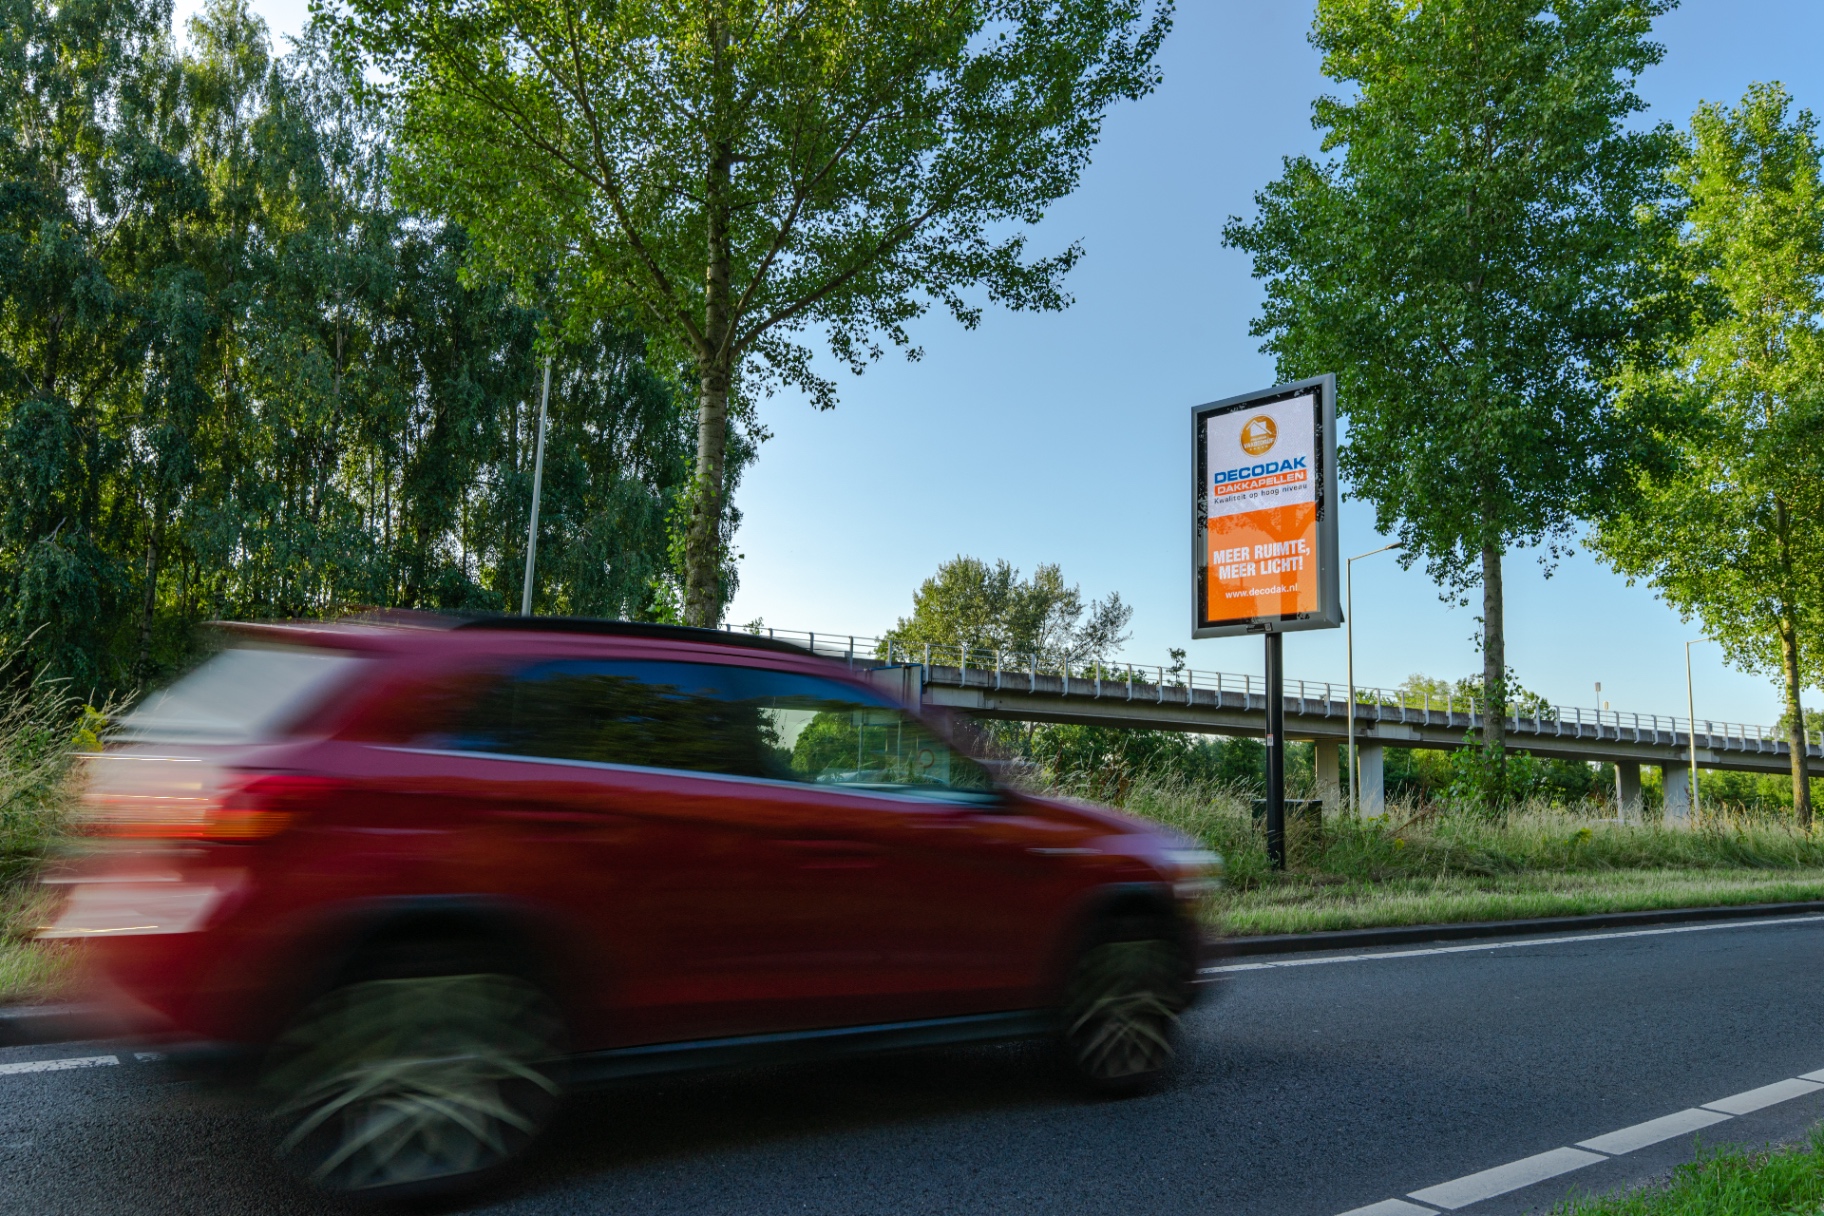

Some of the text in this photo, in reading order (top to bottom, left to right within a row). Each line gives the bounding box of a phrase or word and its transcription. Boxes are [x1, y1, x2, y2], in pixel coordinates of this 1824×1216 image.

[1214, 456, 1307, 484] DECODAK
[1214, 494, 1246, 504] Kwaliteit
[1282, 484, 1307, 492] niveau
[1217, 471, 1305, 494] DAKKAPELLEN
[1213, 538, 1310, 565] MEER RUIMTE,
[1219, 555, 1303, 580] MEER LICHT!
[1225, 583, 1298, 599] www.decodak.nl
